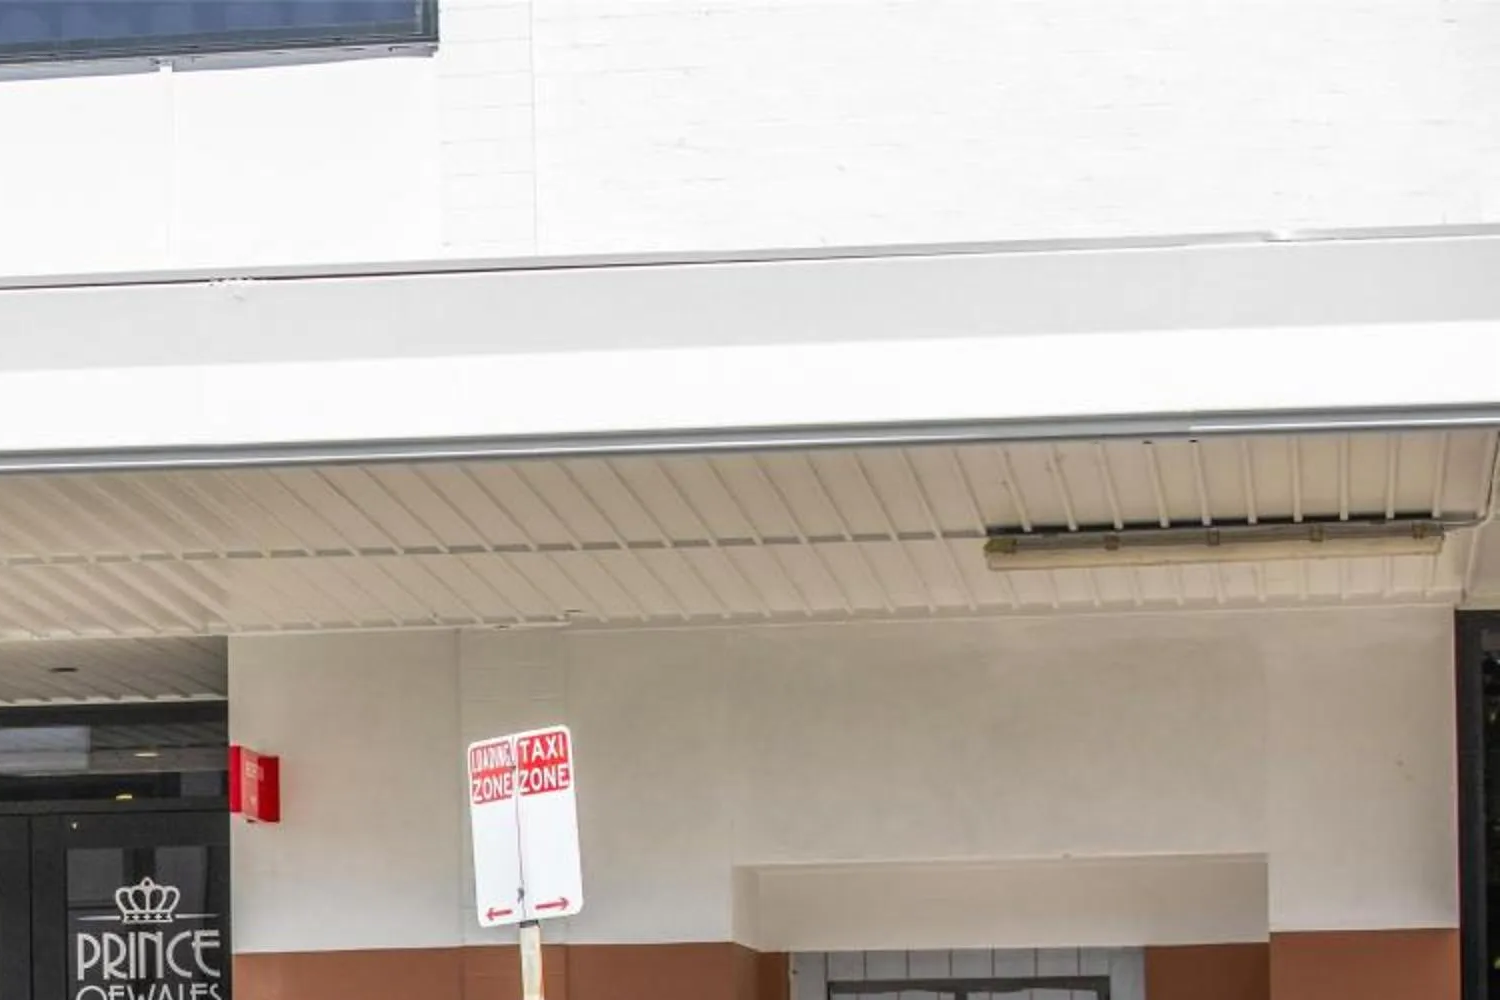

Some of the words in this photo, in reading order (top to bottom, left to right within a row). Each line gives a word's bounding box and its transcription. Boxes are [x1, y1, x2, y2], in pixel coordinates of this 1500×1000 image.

[519, 734, 564, 763] TAXI
[472, 773, 512, 801] ZONE
[519, 764, 569, 793] ZONE
[76, 929, 222, 981] PRINCE
